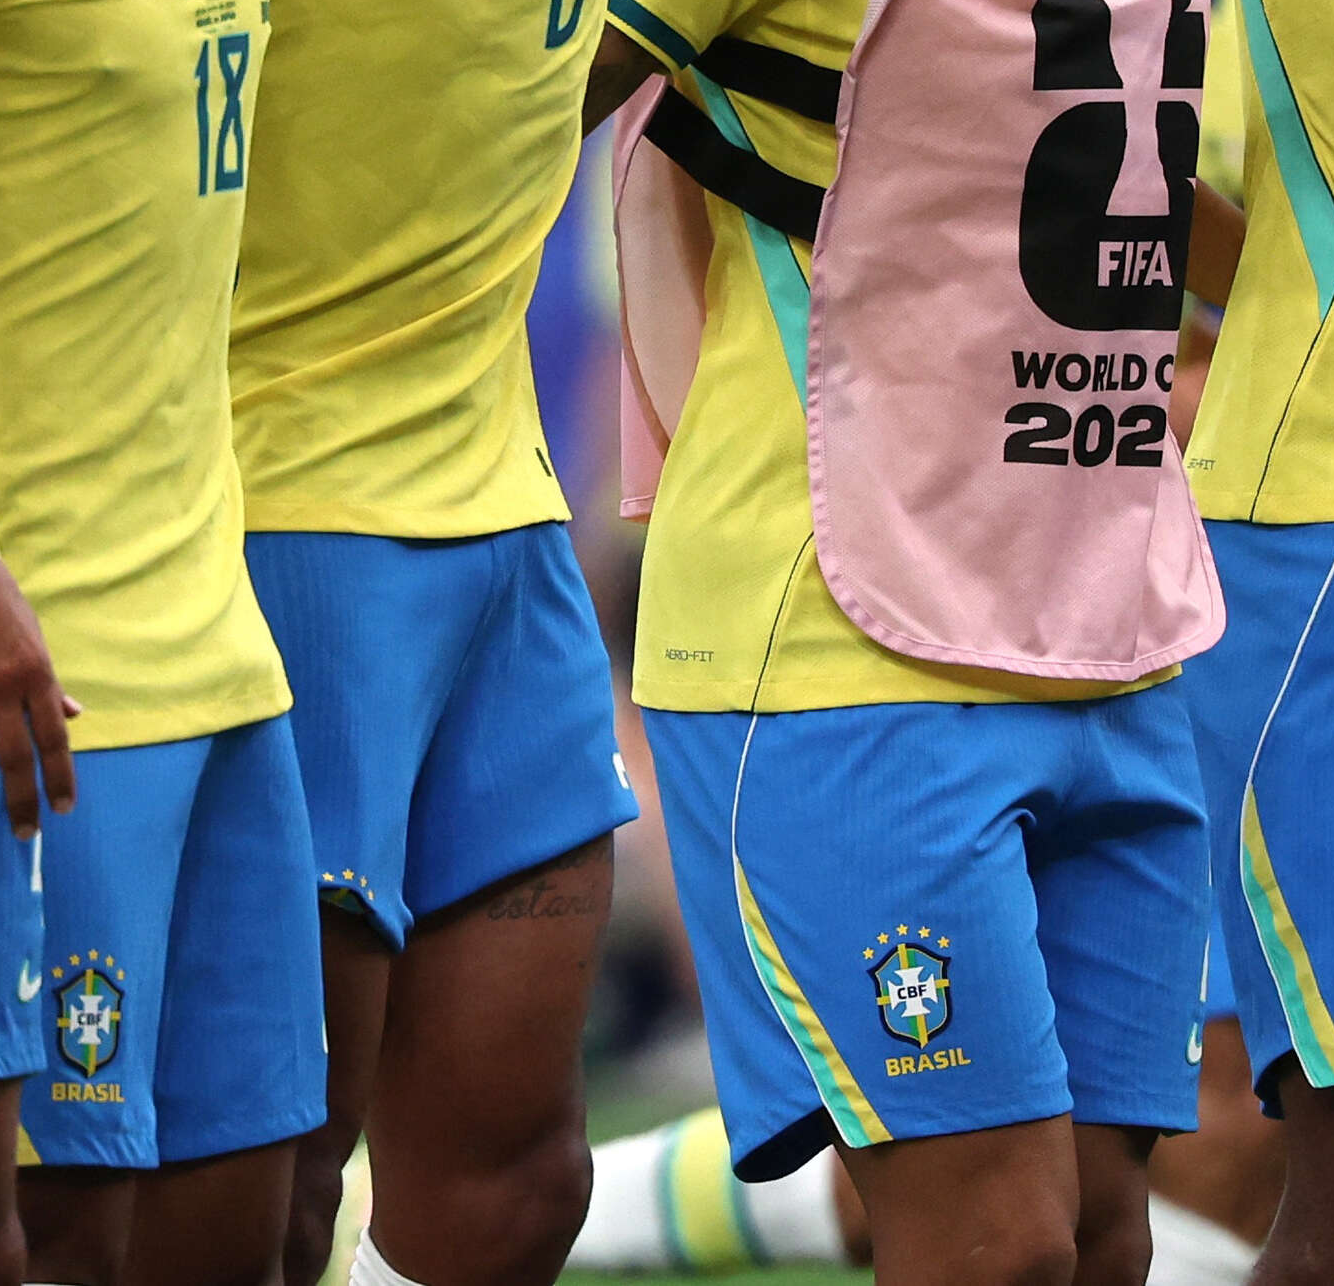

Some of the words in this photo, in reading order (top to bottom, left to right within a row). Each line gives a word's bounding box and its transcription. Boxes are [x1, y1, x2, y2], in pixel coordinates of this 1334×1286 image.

[193, 31, 251, 196] 18
[1097, 240, 1173, 287] FIFA
[1011, 351, 1147, 392] WORLD
[1003, 402, 1167, 467] 202
[897, 984, 927, 999] CBF
[77, 1013, 102, 1026] CBF
[885, 1048, 972, 1077] BRASIL
[51, 1082, 125, 1103] BRASIL
